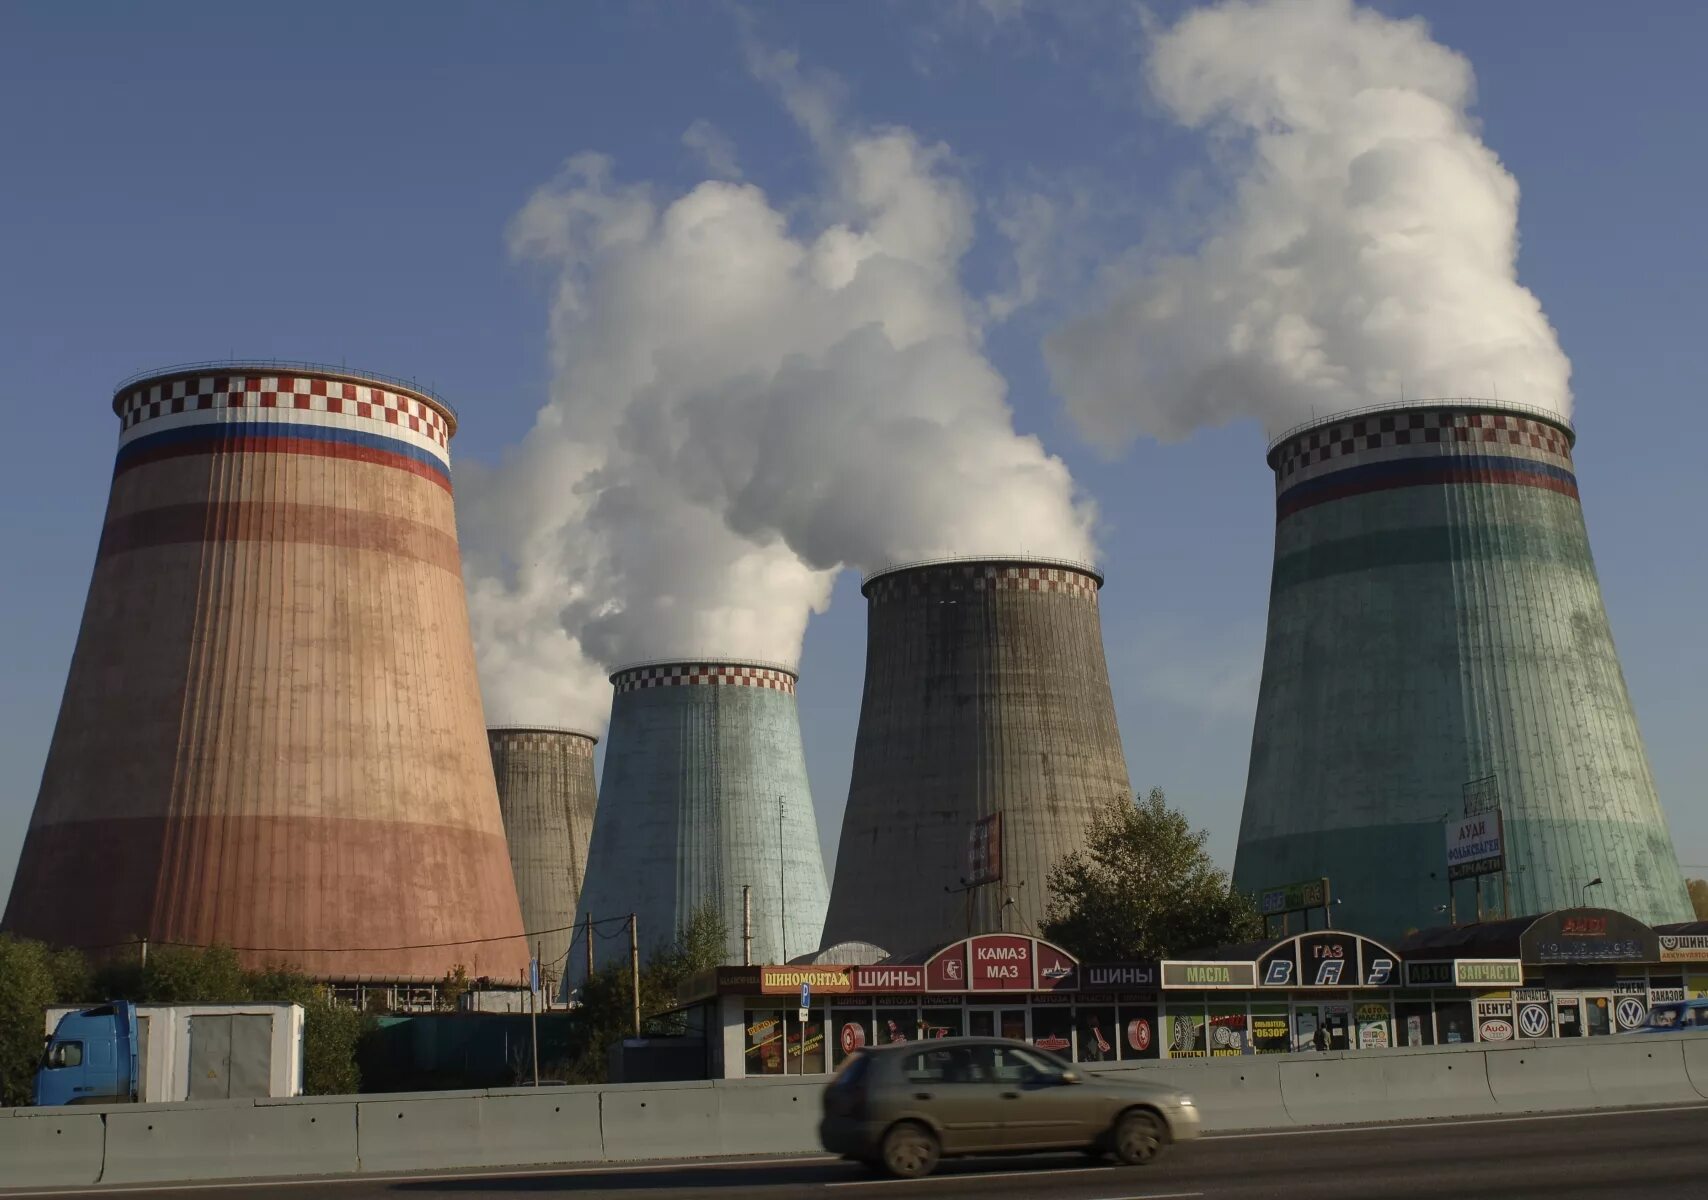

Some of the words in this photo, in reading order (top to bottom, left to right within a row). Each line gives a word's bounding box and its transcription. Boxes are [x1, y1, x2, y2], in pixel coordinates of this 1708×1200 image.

[1459, 822, 1486, 841] АУДИ
[977, 947, 1027, 961] КАМАЗ
[1313, 944, 1343, 959] ГАЗ
[1662, 952, 1708, 960] АККУМУЛЯТО
[764, 972, 851, 987] ШИНОМОНТАЖ
[858, 971, 921, 988] ШИНЫ
[986, 965, 1019, 979] МАЗ
[1089, 967, 1153, 984] ШИНЫ
[1187, 967, 1230, 983] МАСЛА
[1411, 965, 1449, 981] АВТО
[1459, 964, 1520, 981] ЗАПЧАСТИ
[1651, 989, 1684, 1002] ЗАКАЗОВ
[1478, 1002, 1511, 1017] ЦЕНТР
[1484, 1023, 1508, 1033] Audi
